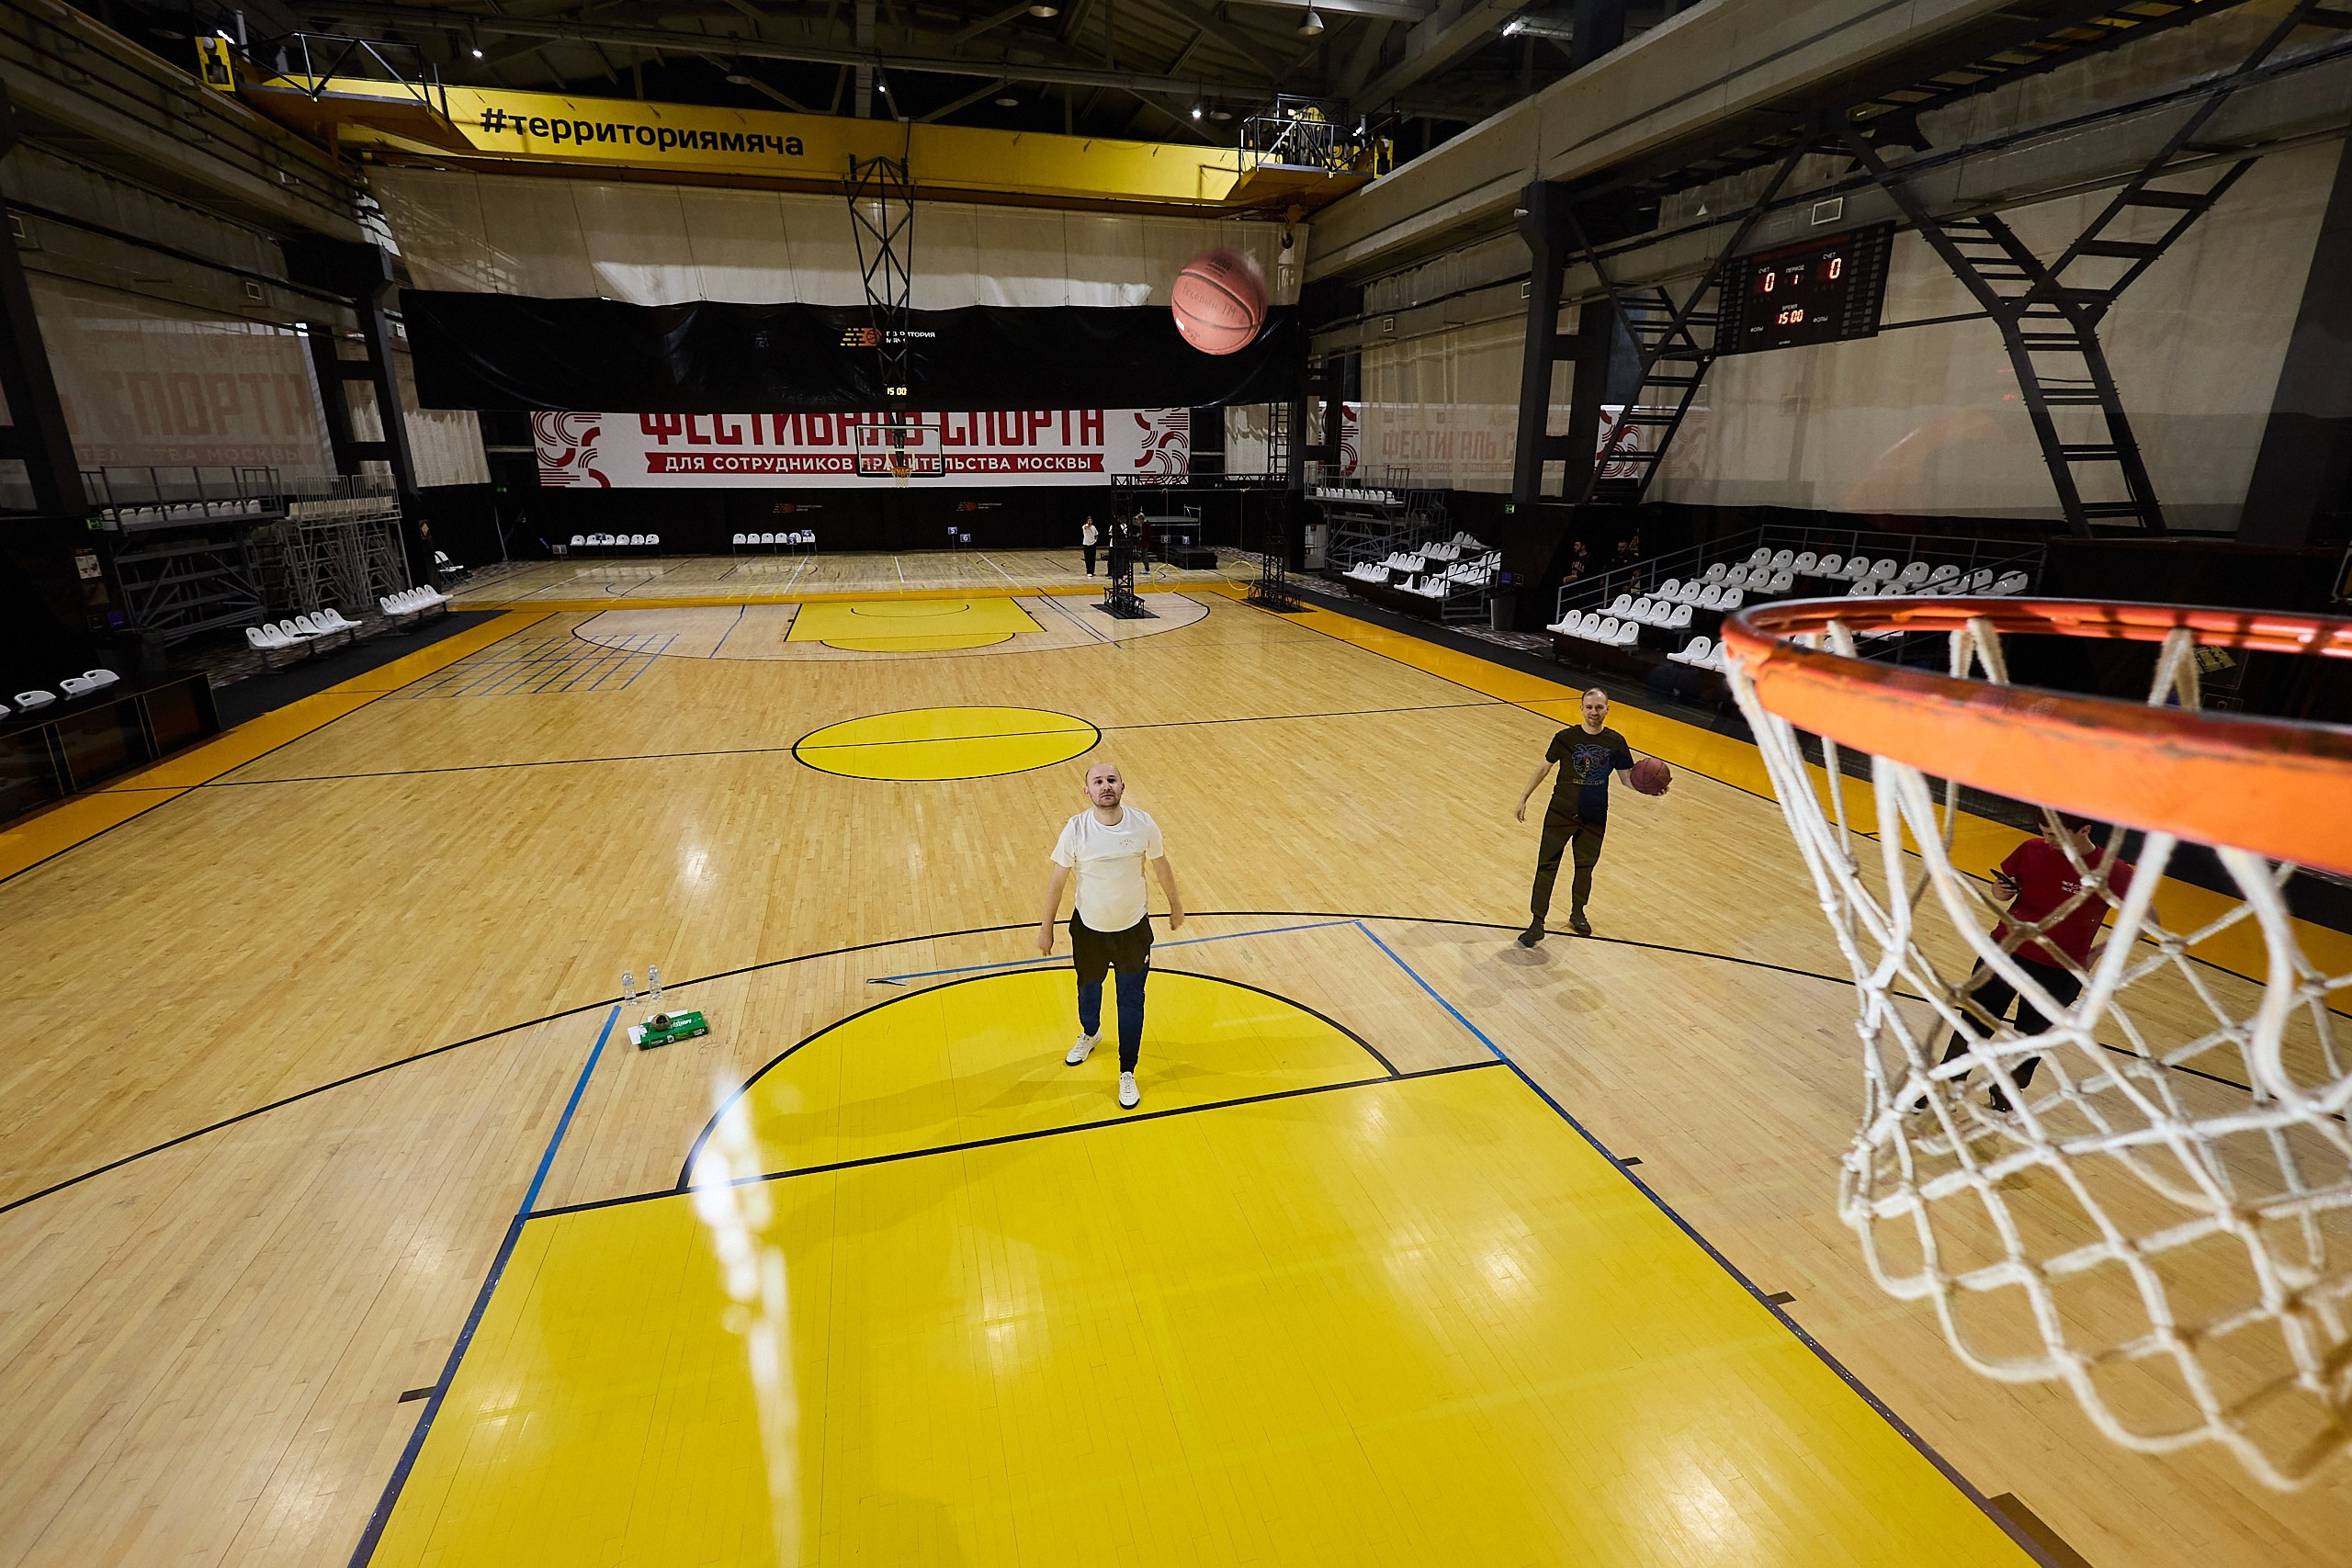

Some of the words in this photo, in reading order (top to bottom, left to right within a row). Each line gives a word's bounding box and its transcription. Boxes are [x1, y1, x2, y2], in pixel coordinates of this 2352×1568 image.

[481, 107, 804, 156] #территориямяча
[1823, 252, 1837, 260] СЧЕТ
[1786, 265, 1804, 274] ПЕРИОД
[1829, 257, 1842, 279] 0
[1764, 272, 1775, 292] 0
[1793, 274, 1799, 286] 1
[664, 457, 706, 472] ДЛЯ
[712, 457, 853, 472] СОТРУДНИКОВ
[860, 457, 1012, 472] ПРАИТЕЛЬСТВА
[1018, 456, 1091, 470] МОСКВЫ
